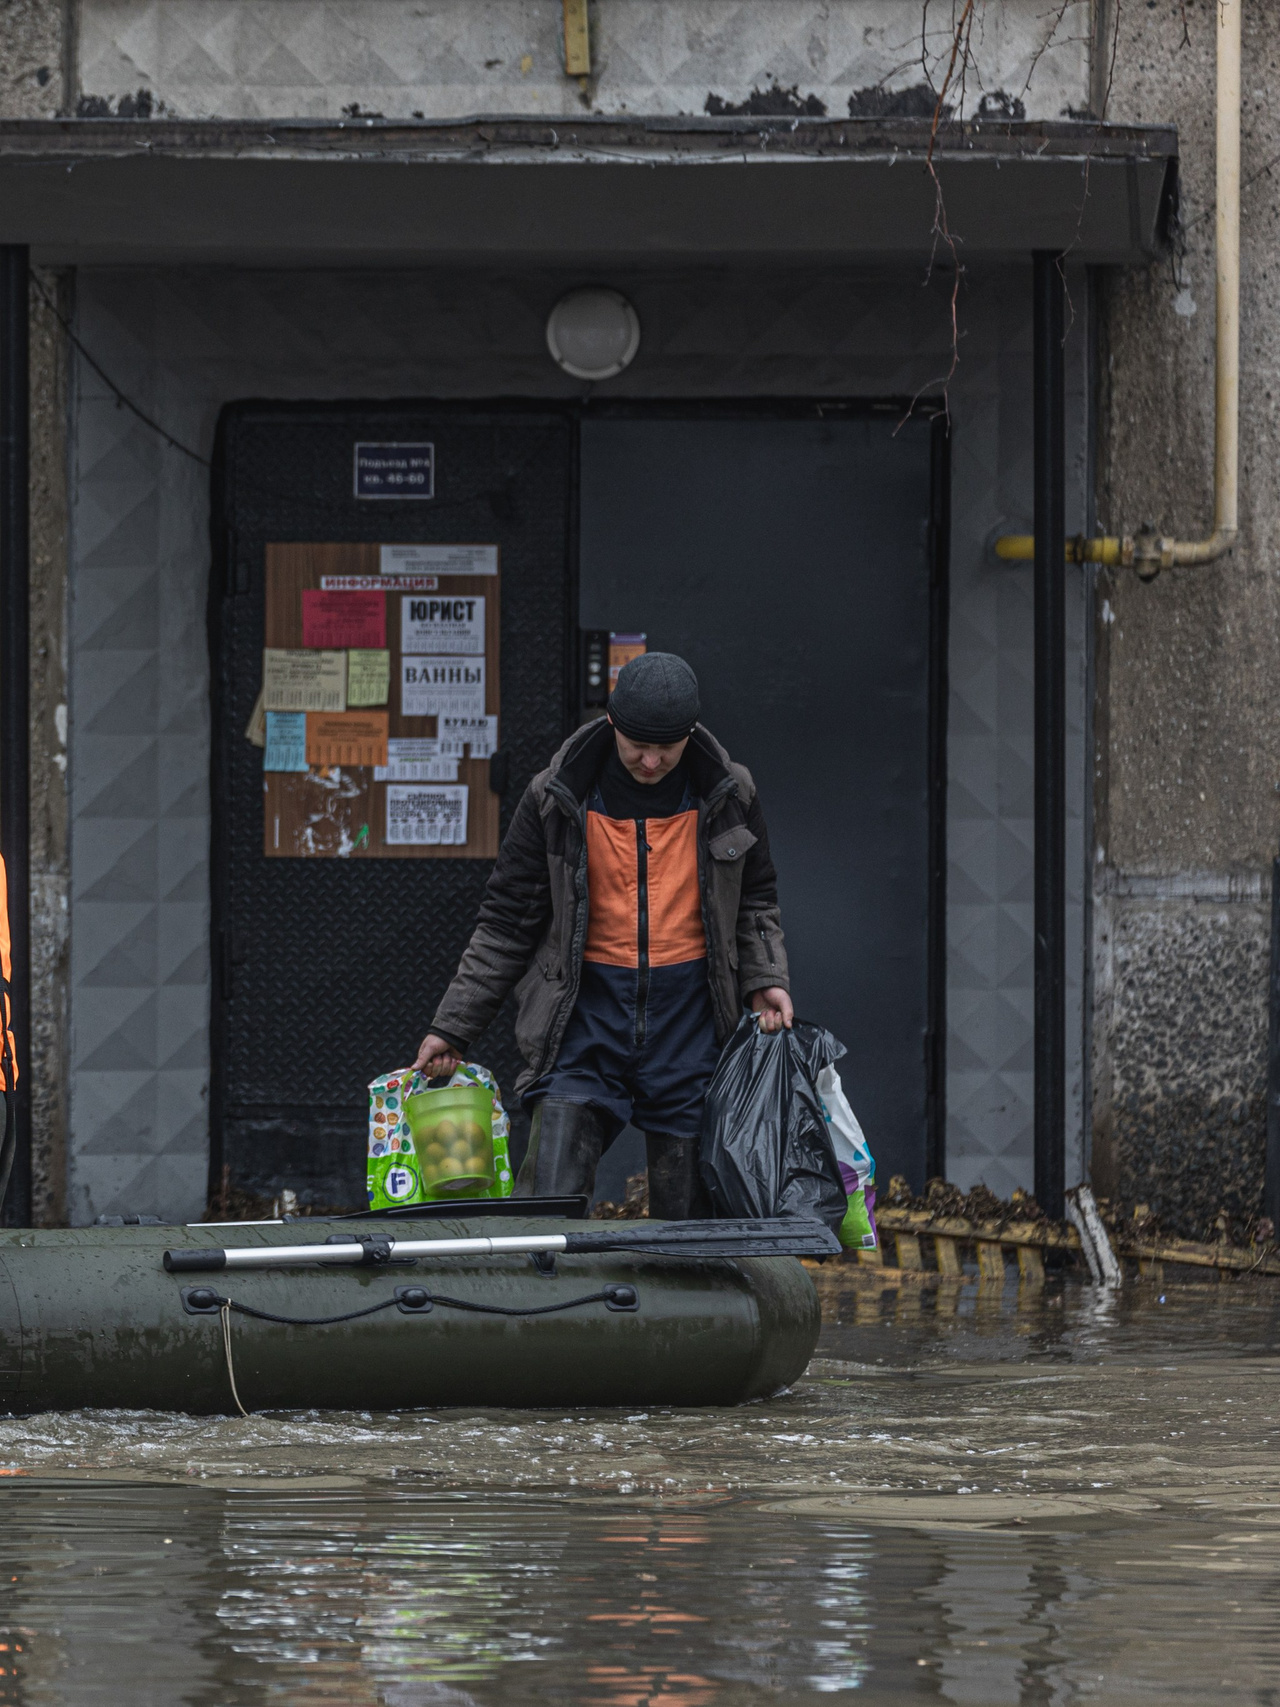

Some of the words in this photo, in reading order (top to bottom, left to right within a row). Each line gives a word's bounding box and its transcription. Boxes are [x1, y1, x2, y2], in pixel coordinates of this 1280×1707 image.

[359, 457, 407, 469] Подъезд
[325, 577, 435, 589] ИНФОРМАЦИЯ
[410, 600, 476, 621] ЮРИСТ
[405, 667, 481, 684] ВАННЫ
[444, 718, 489, 728] КУПЛЮ
[391, 1172, 406, 1194] F
